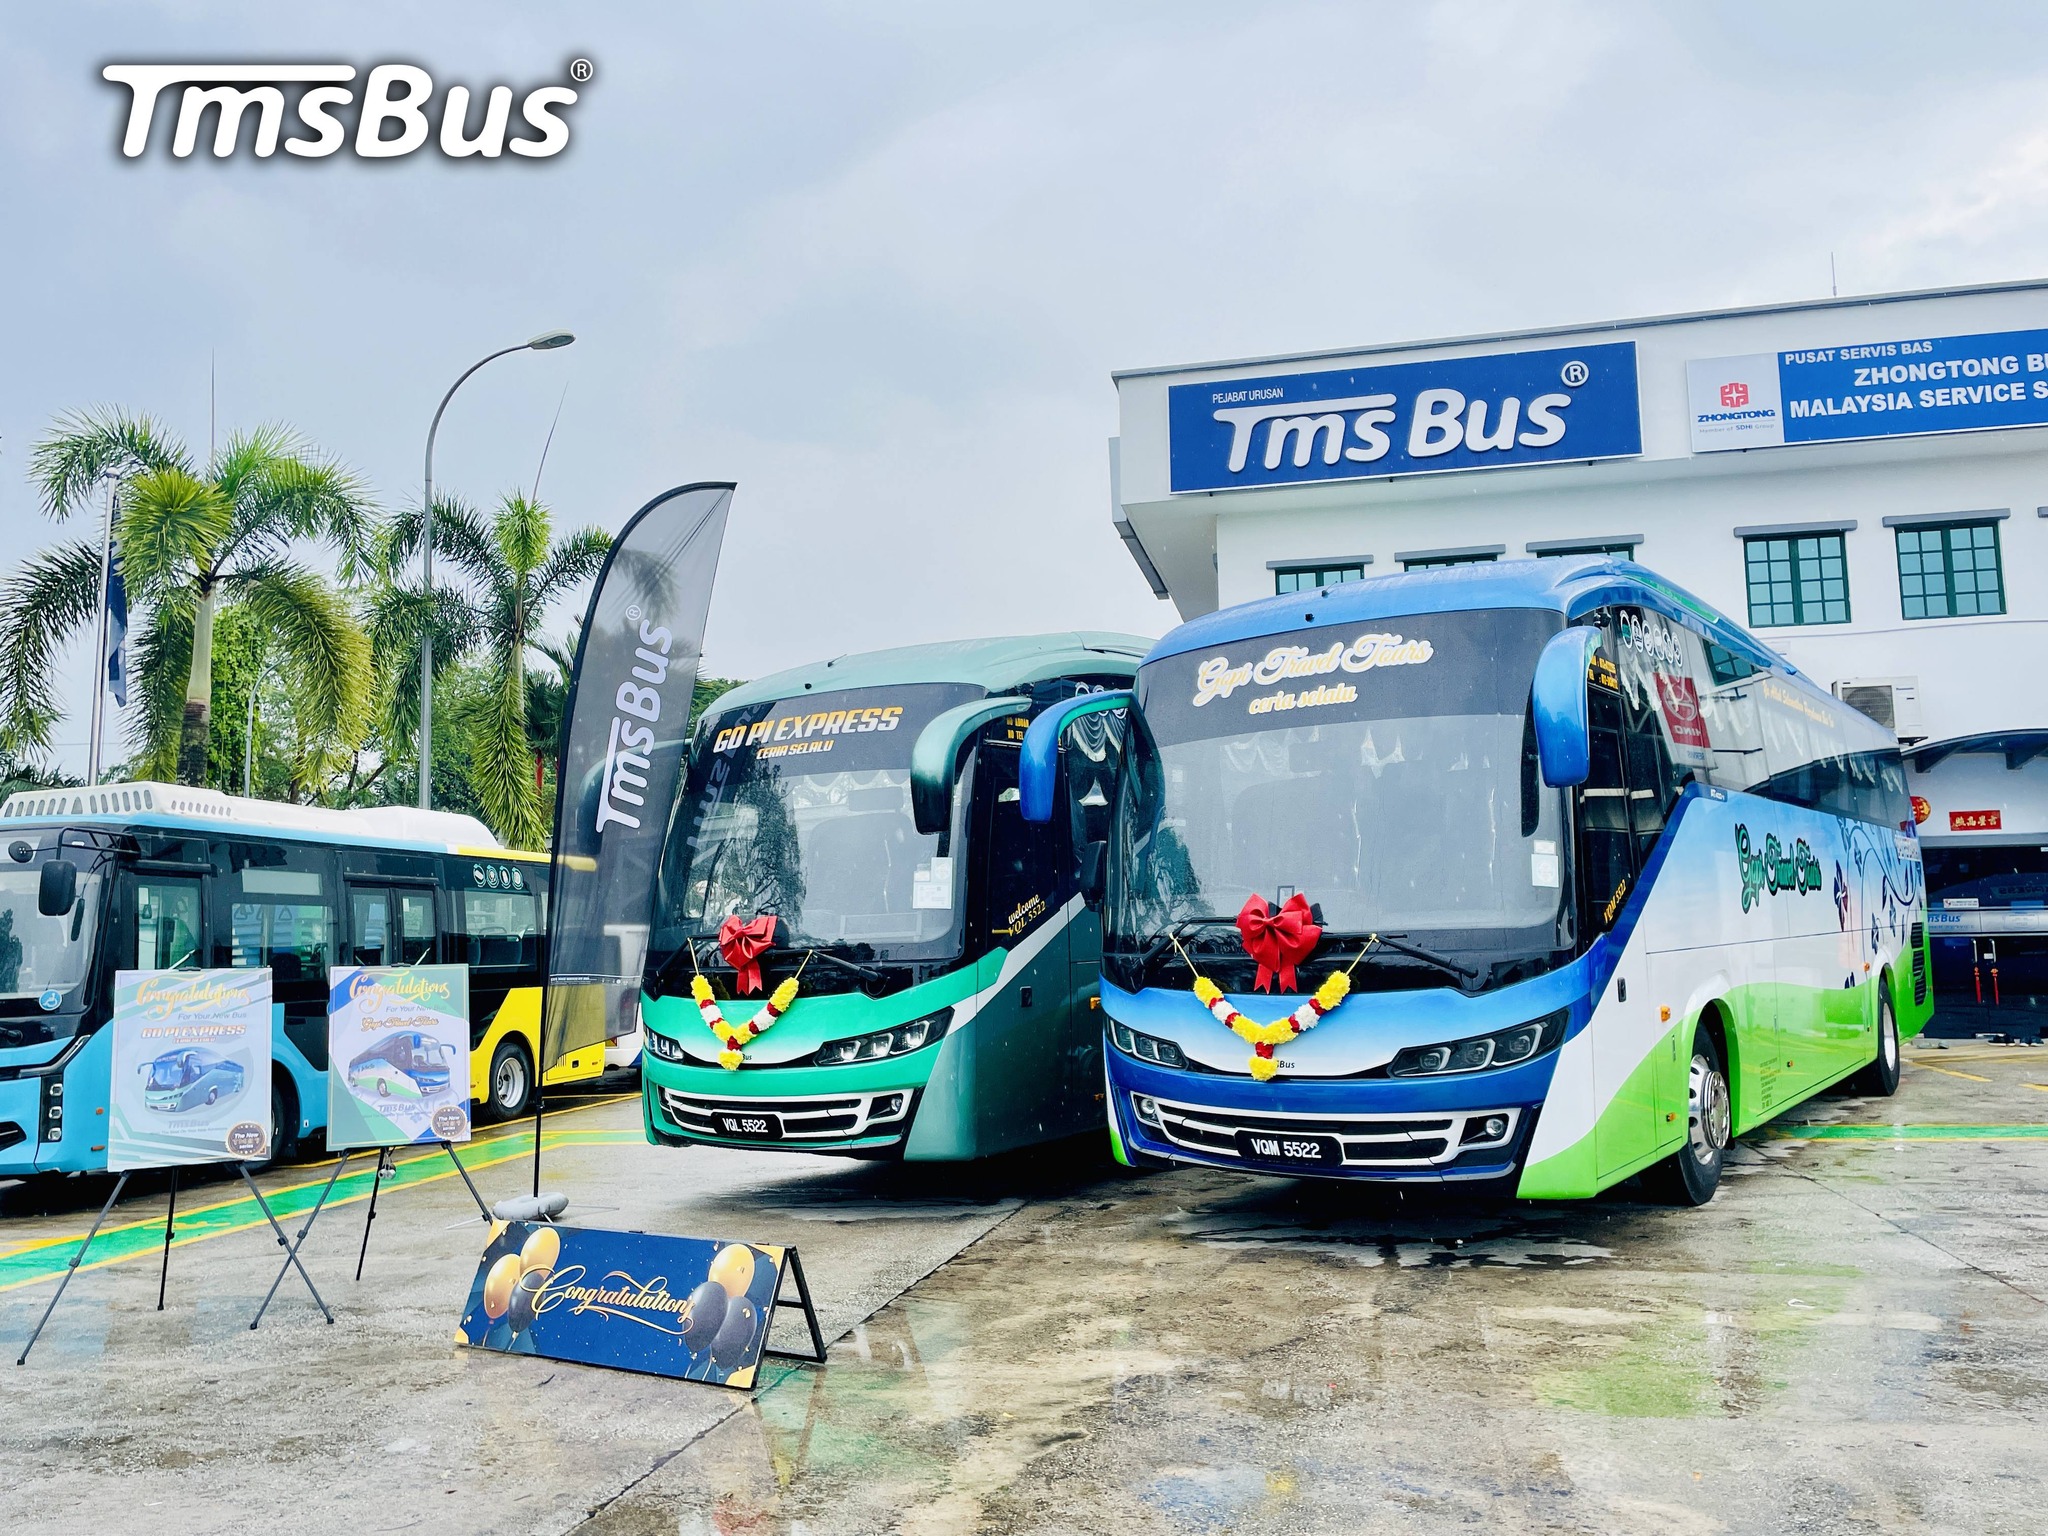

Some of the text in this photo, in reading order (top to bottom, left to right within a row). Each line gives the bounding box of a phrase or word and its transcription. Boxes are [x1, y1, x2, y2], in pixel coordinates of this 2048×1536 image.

[1785, 341, 1933, 365] PUSAT SERVIS BAS
[1854, 355, 2020, 387] ZHONGTONG
[1212, 388, 1284, 404] PEJABAT URUSAN
[1790, 391, 1914, 419] MALAYSIA
[1920, 382, 2026, 408] SERVICE
[1213, 393, 1397, 473] Tms
[1408, 388, 1572, 458] Bus
[1697, 409, 1776, 423] ZHONGTONG
[1253, 641, 1344, 685] Travel
[1341, 632, 1434, 673] Tours
[1249, 682, 1358, 714] ceria selalu
[713, 706, 904, 754] GO PI EXPRESS
[756, 740, 835, 760] CERIA SELALU
[1008, 894, 1041, 925] welcome
[1028, 900, 1046, 922] 5522
[349, 970, 450, 1014] Congratulations
[180, 1024, 248, 1037] EXPRESS
[741, 1119, 769, 1133] 5522
[1250, 1138, 1322, 1159] VQM 5522
[519, 1265, 696, 1335] Congratulations
